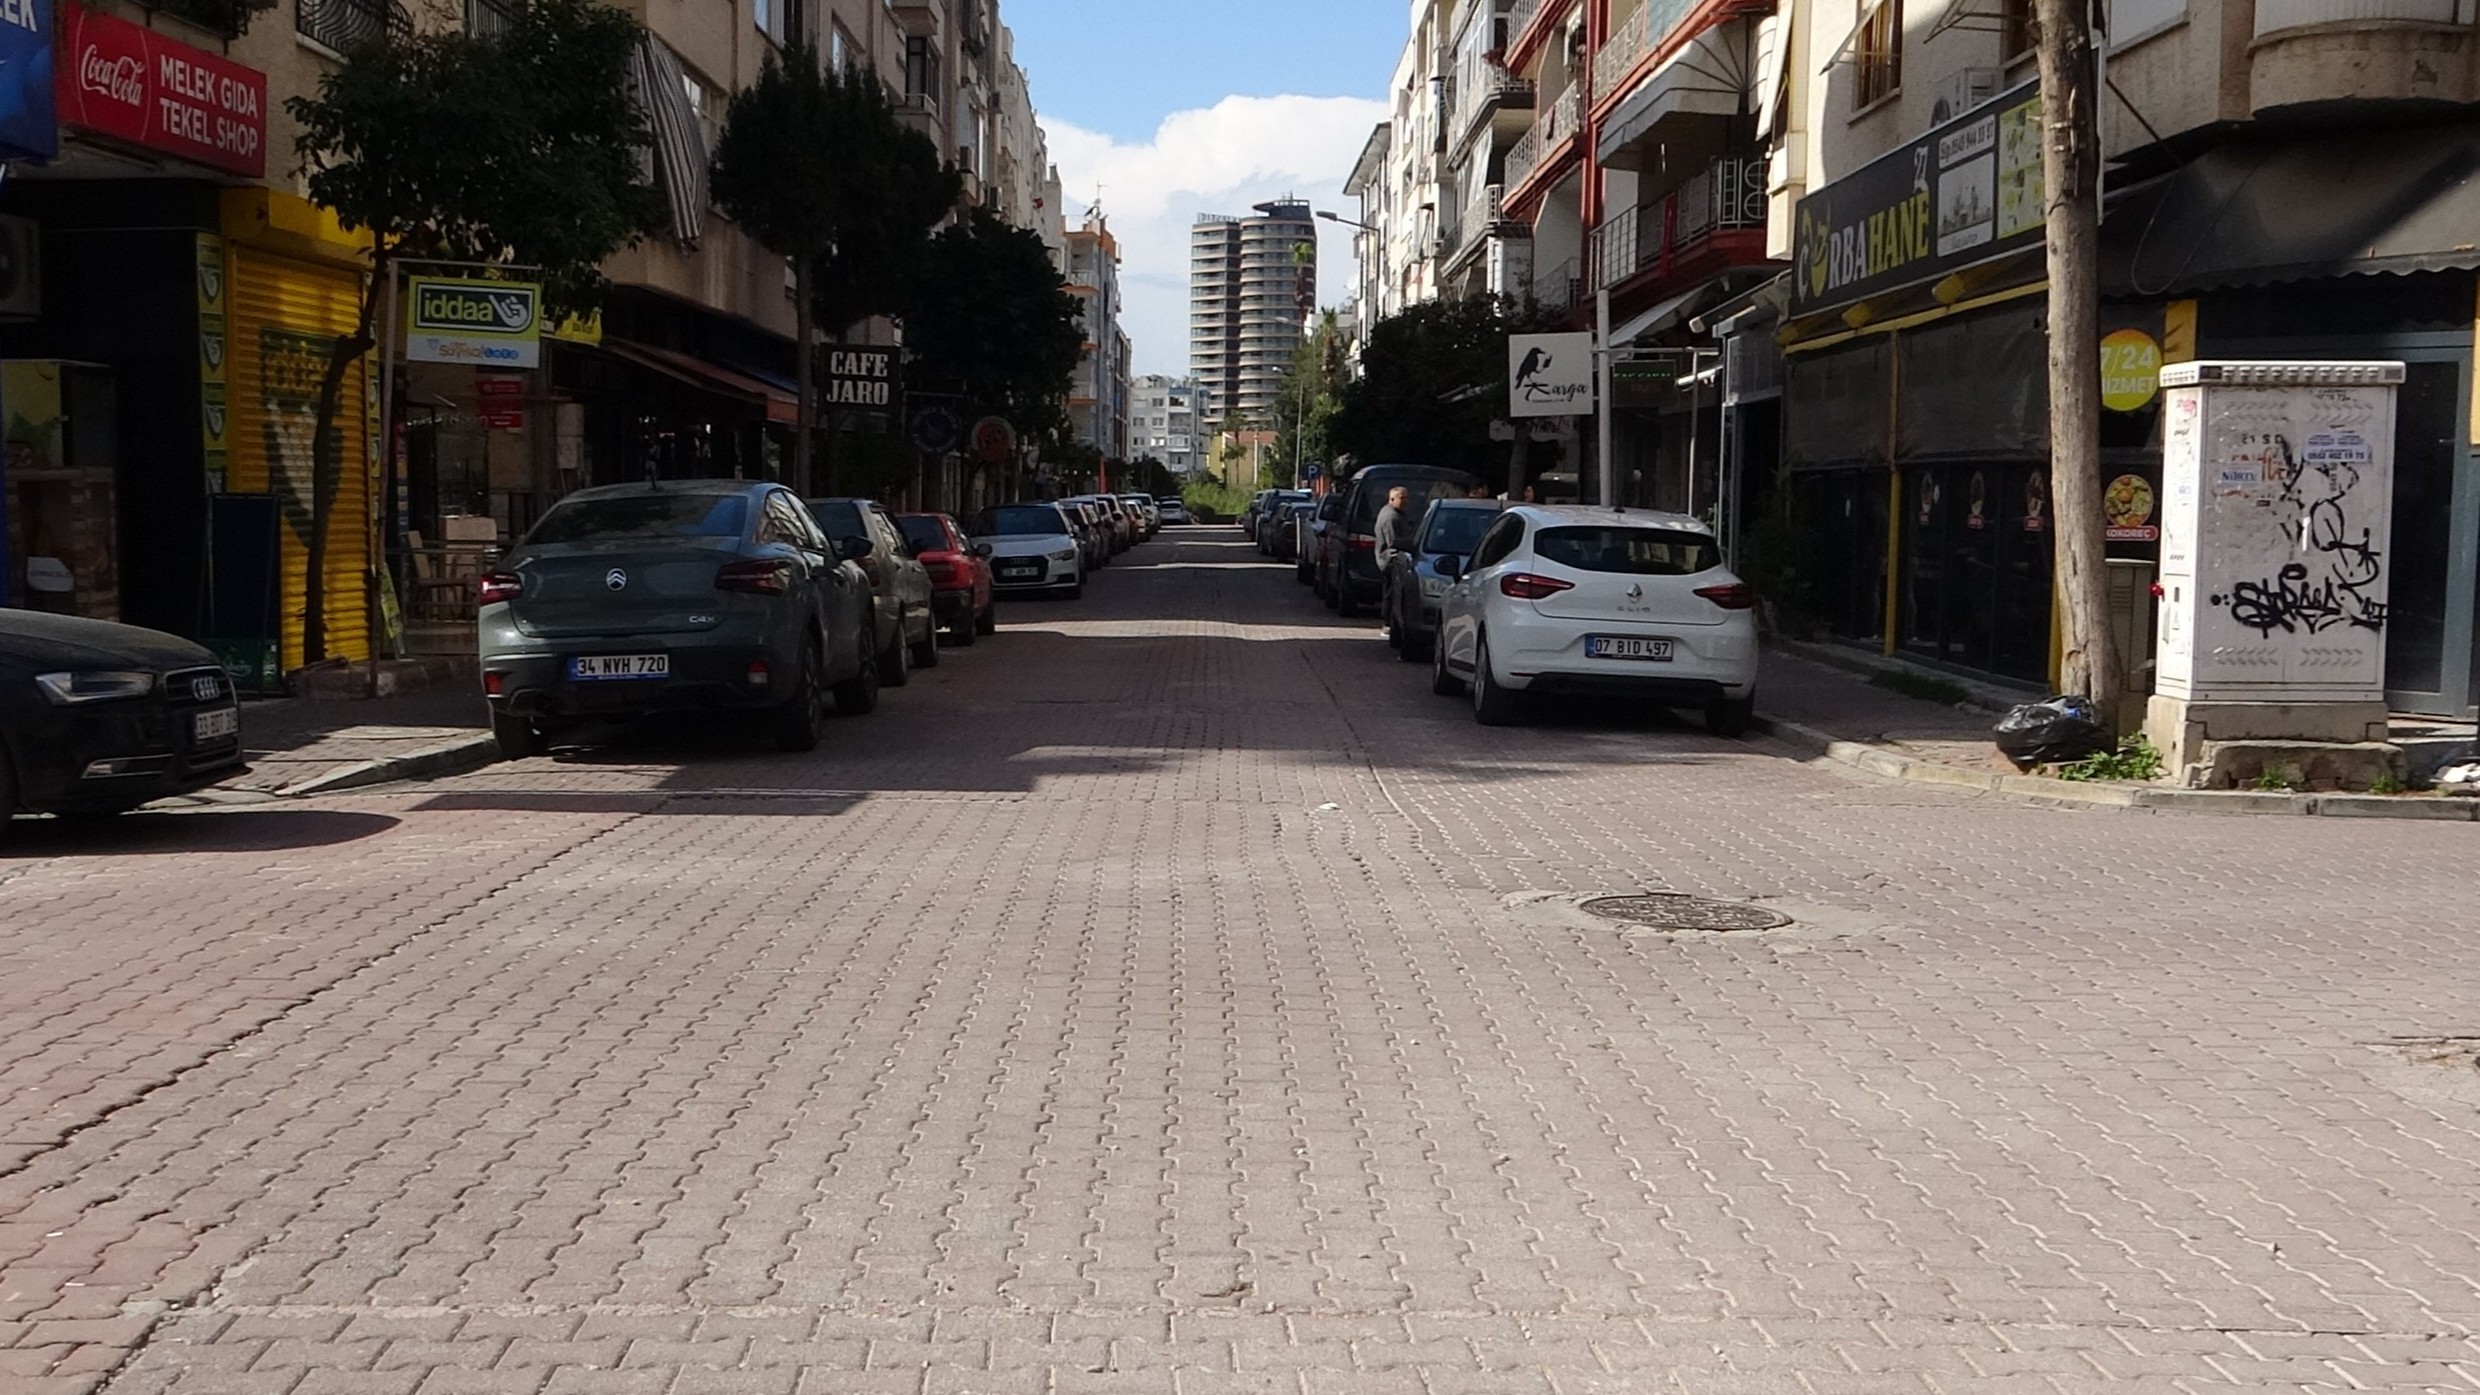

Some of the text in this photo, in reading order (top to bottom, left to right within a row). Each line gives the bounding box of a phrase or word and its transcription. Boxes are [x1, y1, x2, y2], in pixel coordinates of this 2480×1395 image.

[0, 0, 37, 33] EK
[160, 54, 259, 119] MELEK GIDA
[159, 97, 258, 157] TEKEL SHOP
[424, 292, 494, 322] iddaa
[830, 351, 889, 377] CAFE
[2100, 345, 2154, 372] 7/24
[827, 379, 889, 405] JARO
[1523, 382, 1589, 403] Karga
[1595, 639, 1611, 653] 07
[1646, 641, 1669, 656] 497
[579, 656, 666, 674] 34 NVH 720
